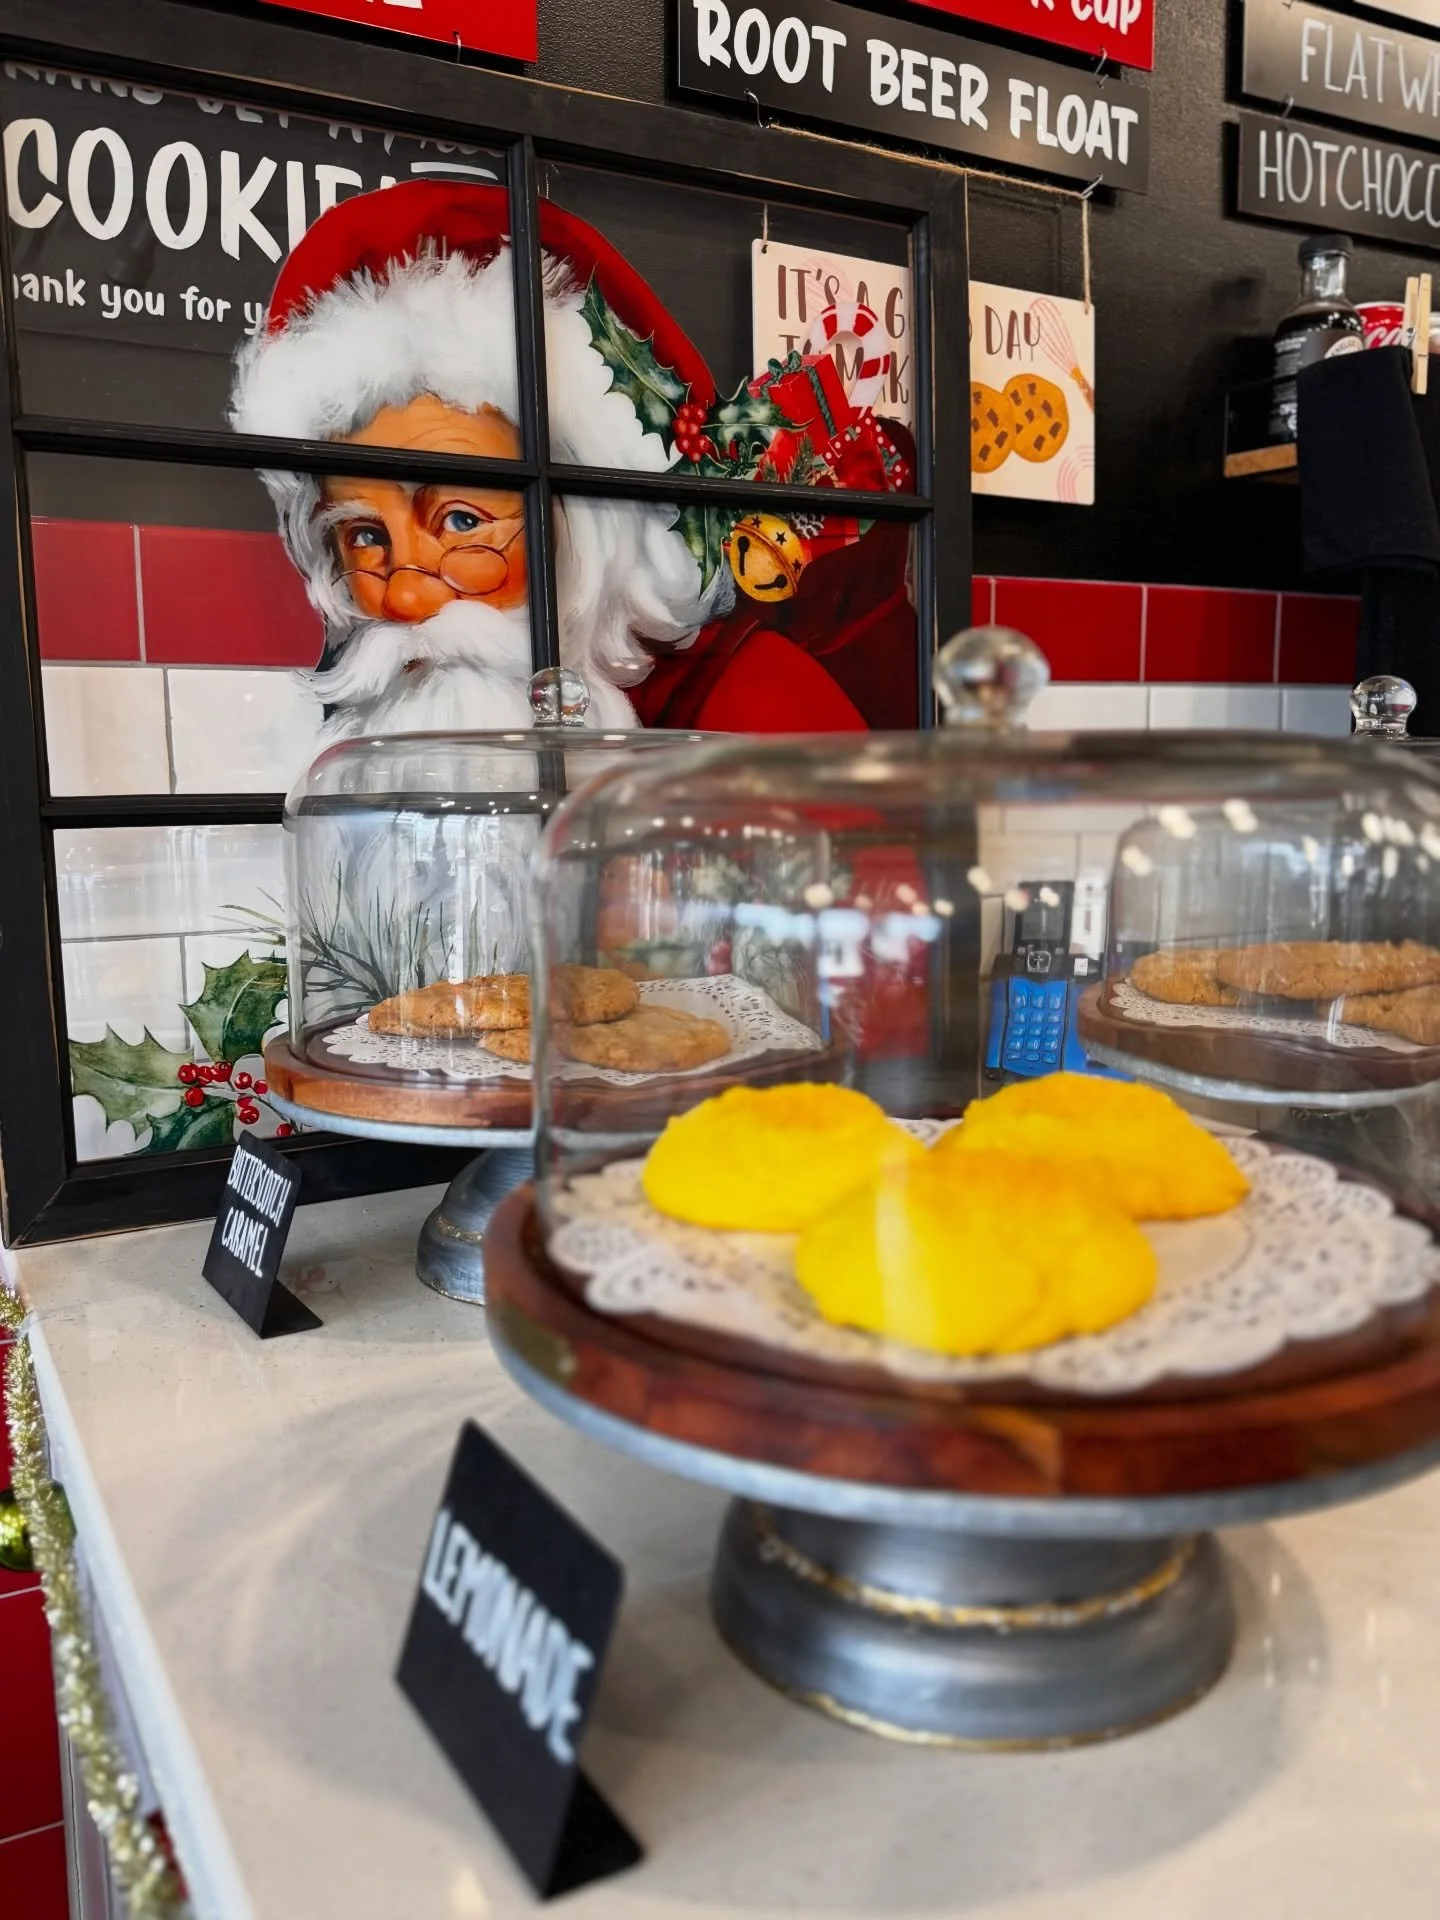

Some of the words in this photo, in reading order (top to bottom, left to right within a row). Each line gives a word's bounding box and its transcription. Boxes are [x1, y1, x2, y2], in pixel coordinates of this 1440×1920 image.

[693, 0, 847, 93] ROOT
[866, 39, 988, 131] BEER
[1009, 78, 1139, 165] FLOAT
[100, 283, 164, 319] you
[180, 285, 231, 322] for
[778, 264, 840, 323] IT'S
[984, 304, 1041, 362] DAY
[227, 1144, 292, 1228] BUTTERSCOTCH
[221, 1206, 269, 1278] CARAMEL
[422, 1507, 595, 1764] LEMONADE
